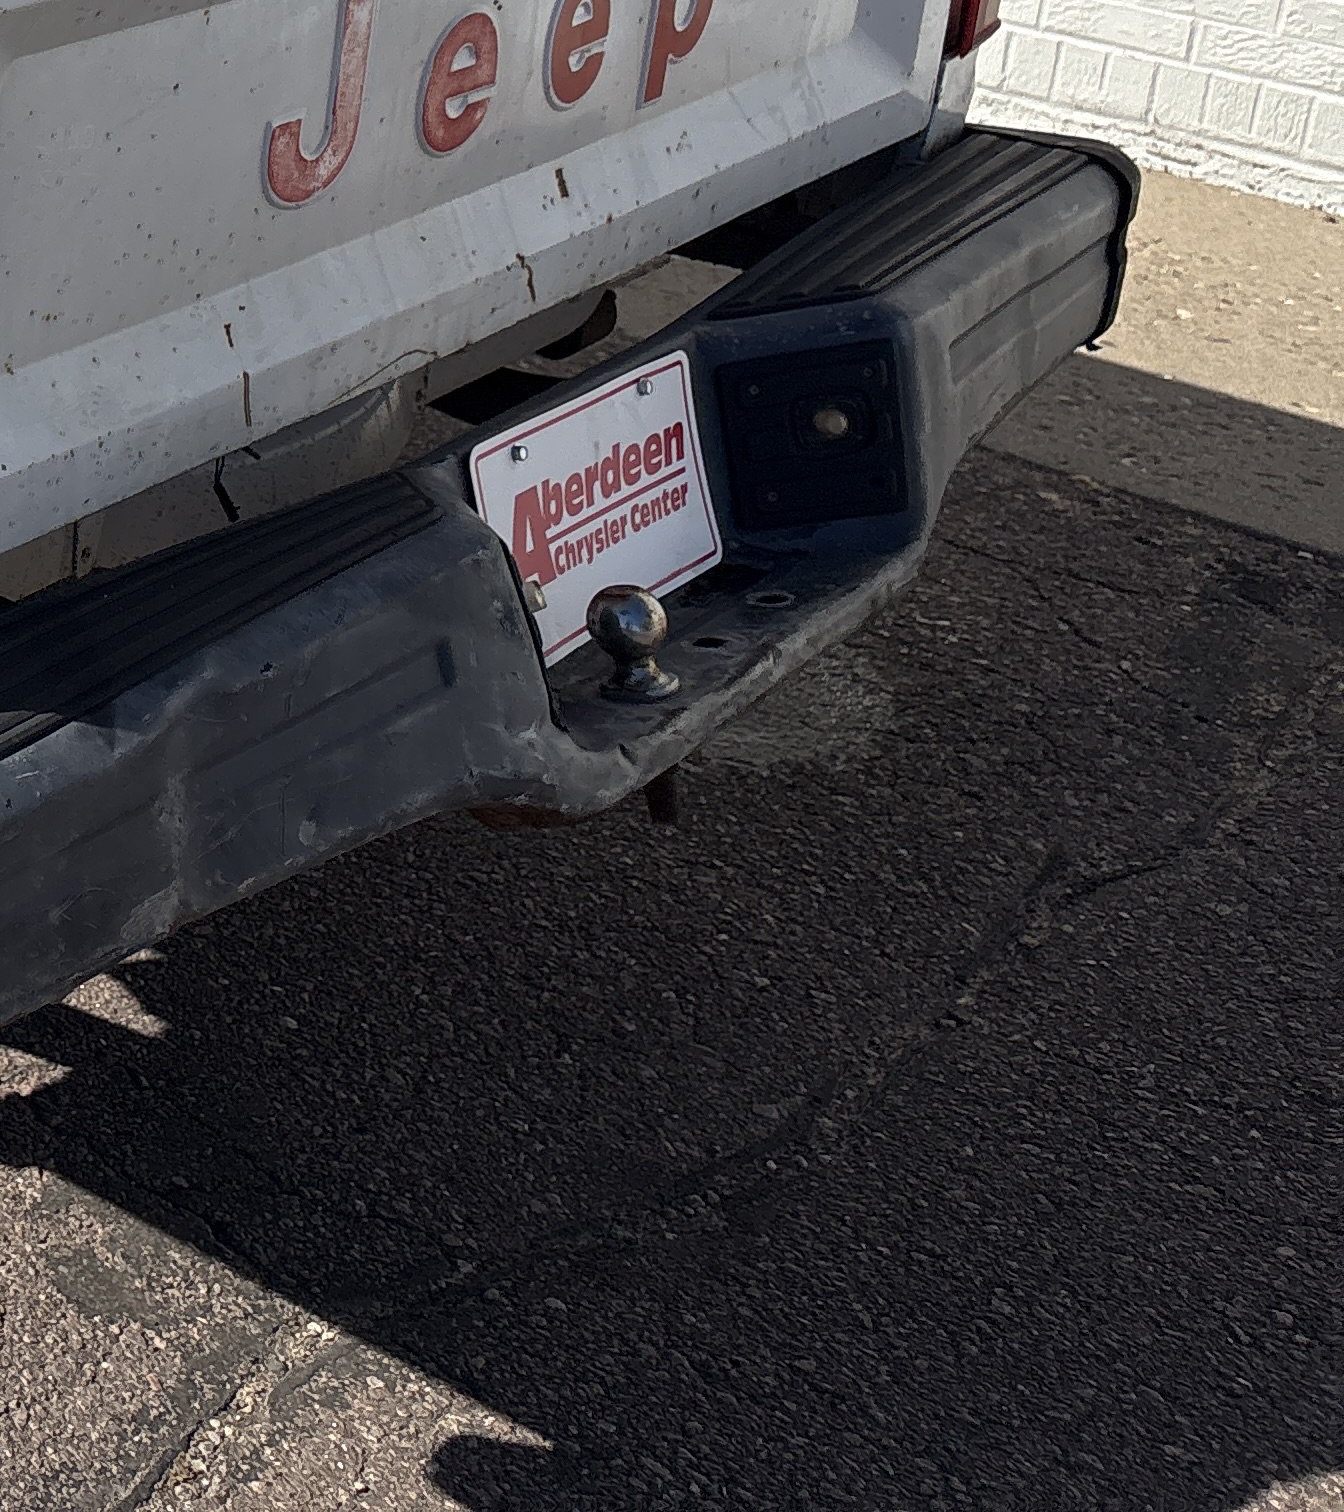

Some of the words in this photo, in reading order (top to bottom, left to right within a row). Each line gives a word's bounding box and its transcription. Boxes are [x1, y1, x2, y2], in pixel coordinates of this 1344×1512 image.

[511, 420, 686, 588] Aberdeen
[553, 502, 630, 576] Chrysler
[630, 482, 689, 532] Center
